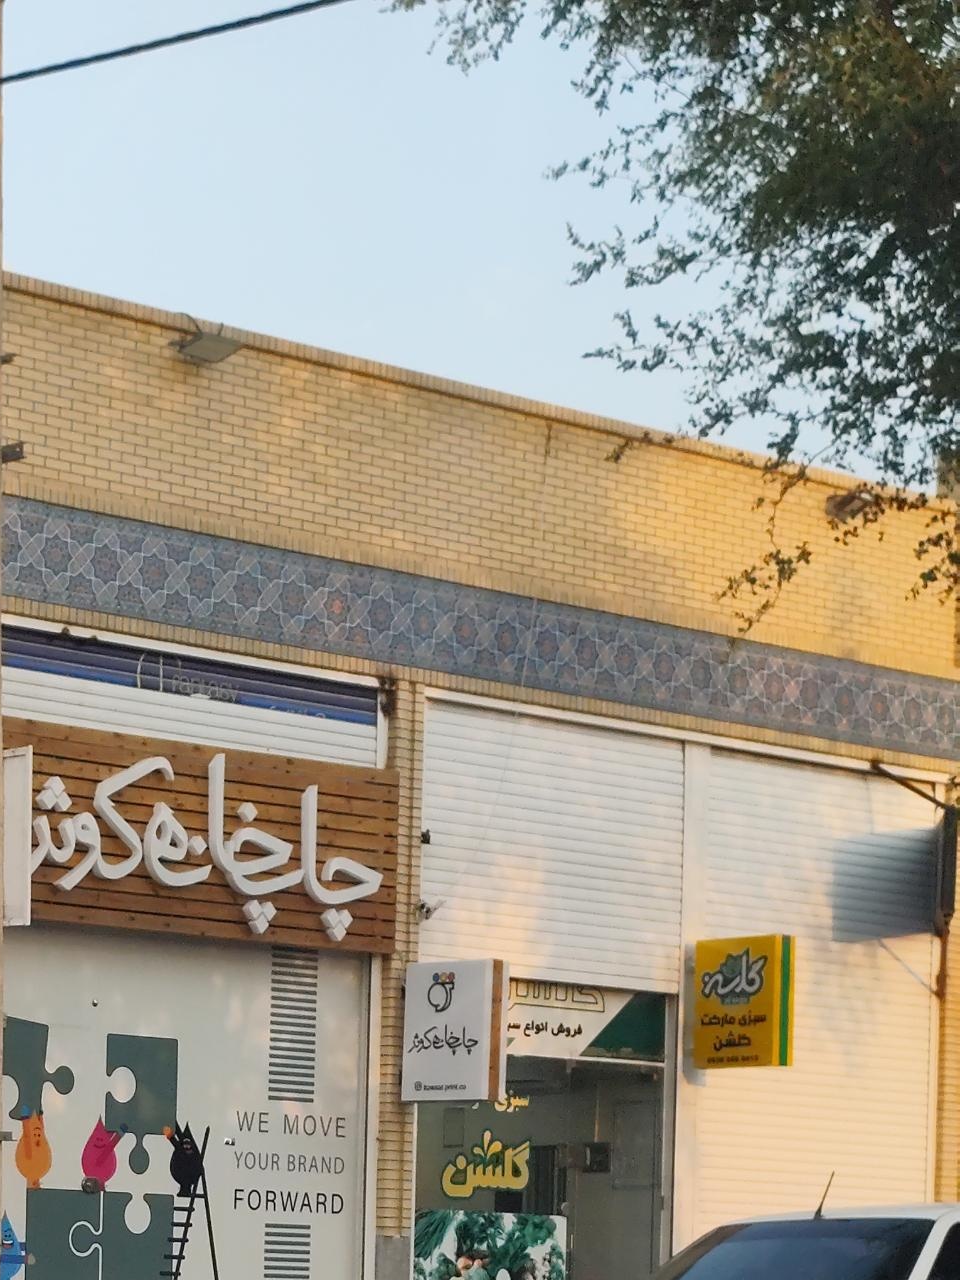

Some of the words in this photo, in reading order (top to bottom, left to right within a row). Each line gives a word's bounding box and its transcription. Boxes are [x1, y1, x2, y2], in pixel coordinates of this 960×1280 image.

[523, 1020, 548, 1036] انواع
[551, 1023, 583, 1037] فروش
[236, 1110, 269, 1133] WE
[283, 1114, 347, 1138] MOVE
[234, 1151, 280, 1171] YOUR
[287, 1153, 345, 1175] BRAND
[233, 1188, 344, 1214] FORWARD
